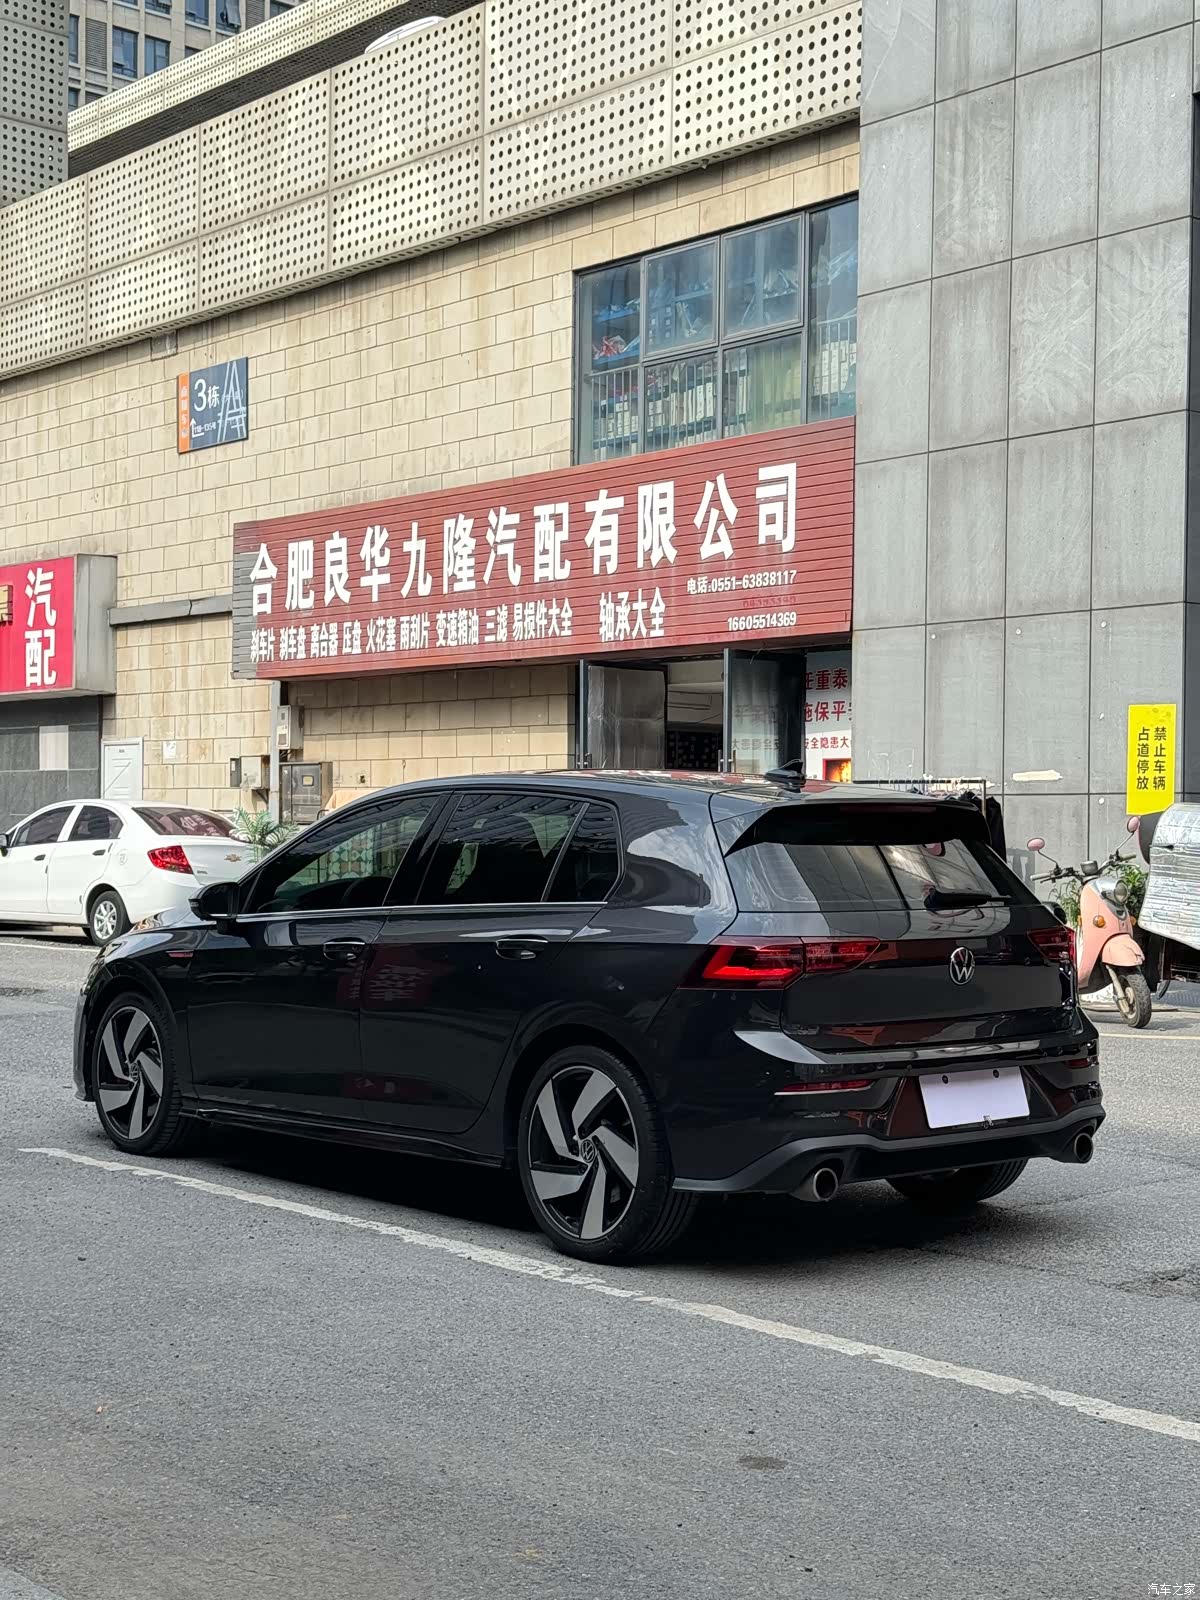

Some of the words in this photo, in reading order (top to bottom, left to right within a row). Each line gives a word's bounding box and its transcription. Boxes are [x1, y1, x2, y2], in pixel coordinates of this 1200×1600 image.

[193, 378, 220, 412] 3栋
[249, 462, 798, 617] 合肥良华九隆汽配有限公司
[686, 569, 798, 595] 电话:0551-63838117
[24, 567, 57, 687] 汽配
[250, 627, 276, 664] 刹车片
[279, 625, 307, 661] 刹车盘
[310, 622, 339, 658] 离合器
[342, 619, 362, 655] 压盘
[366, 616, 397, 654] 火花塞
[400, 612, 430, 650] 雨刮片
[435, 607, 479, 648] 变速箱油
[484, 603, 508, 643] 三滤
[512, 597, 573, 641] 易损件大全
[599, 586, 666, 643] 轴承大全
[727, 611, 797, 632] 16605514369
[1136, 726, 1151, 791] 占道停放
[1152, 726, 1167, 791] 禁止车辆
